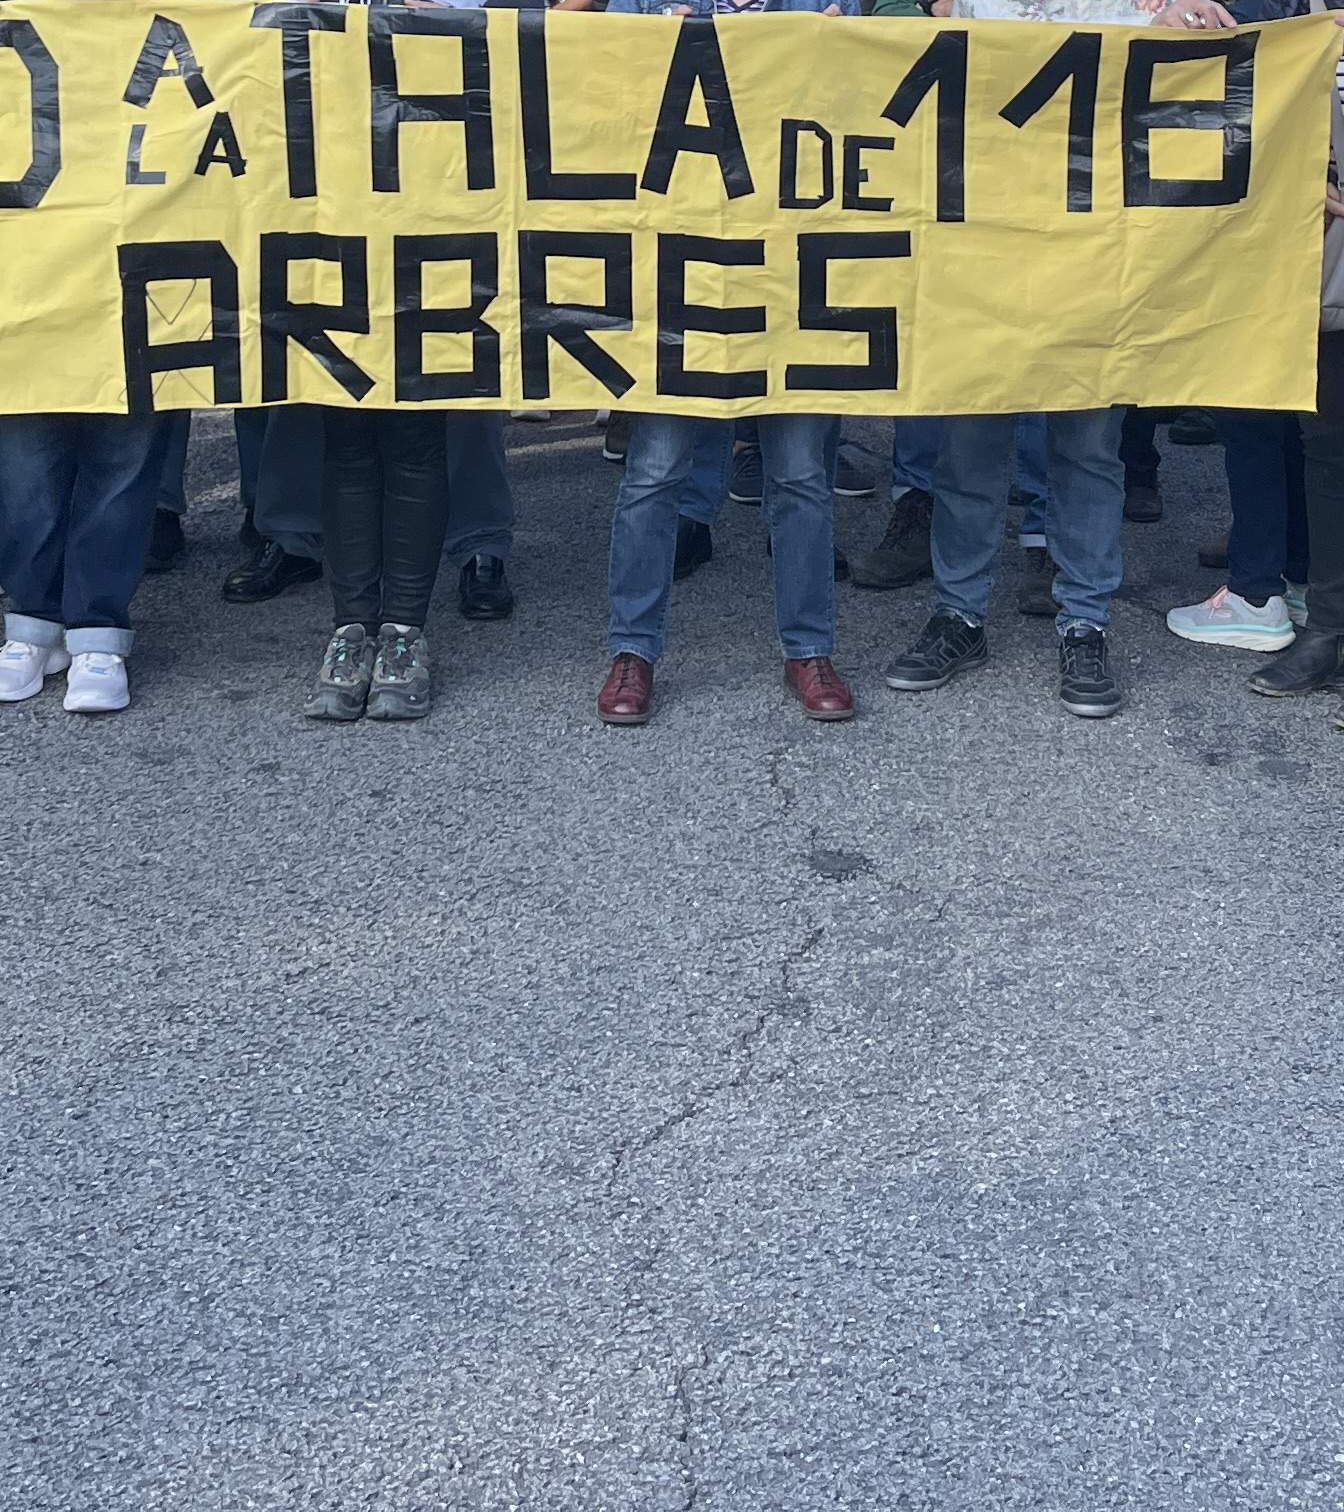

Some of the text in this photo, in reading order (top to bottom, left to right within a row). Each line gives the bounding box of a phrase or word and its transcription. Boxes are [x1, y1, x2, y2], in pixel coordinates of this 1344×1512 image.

[122, 14, 218, 110] A
[251, 2, 755, 201] TALA
[881, 29, 1262, 223] 118
[126, 110, 248, 186] LA
[778, 118, 896, 212] DE
[117, 229, 912, 414] ARBRES
